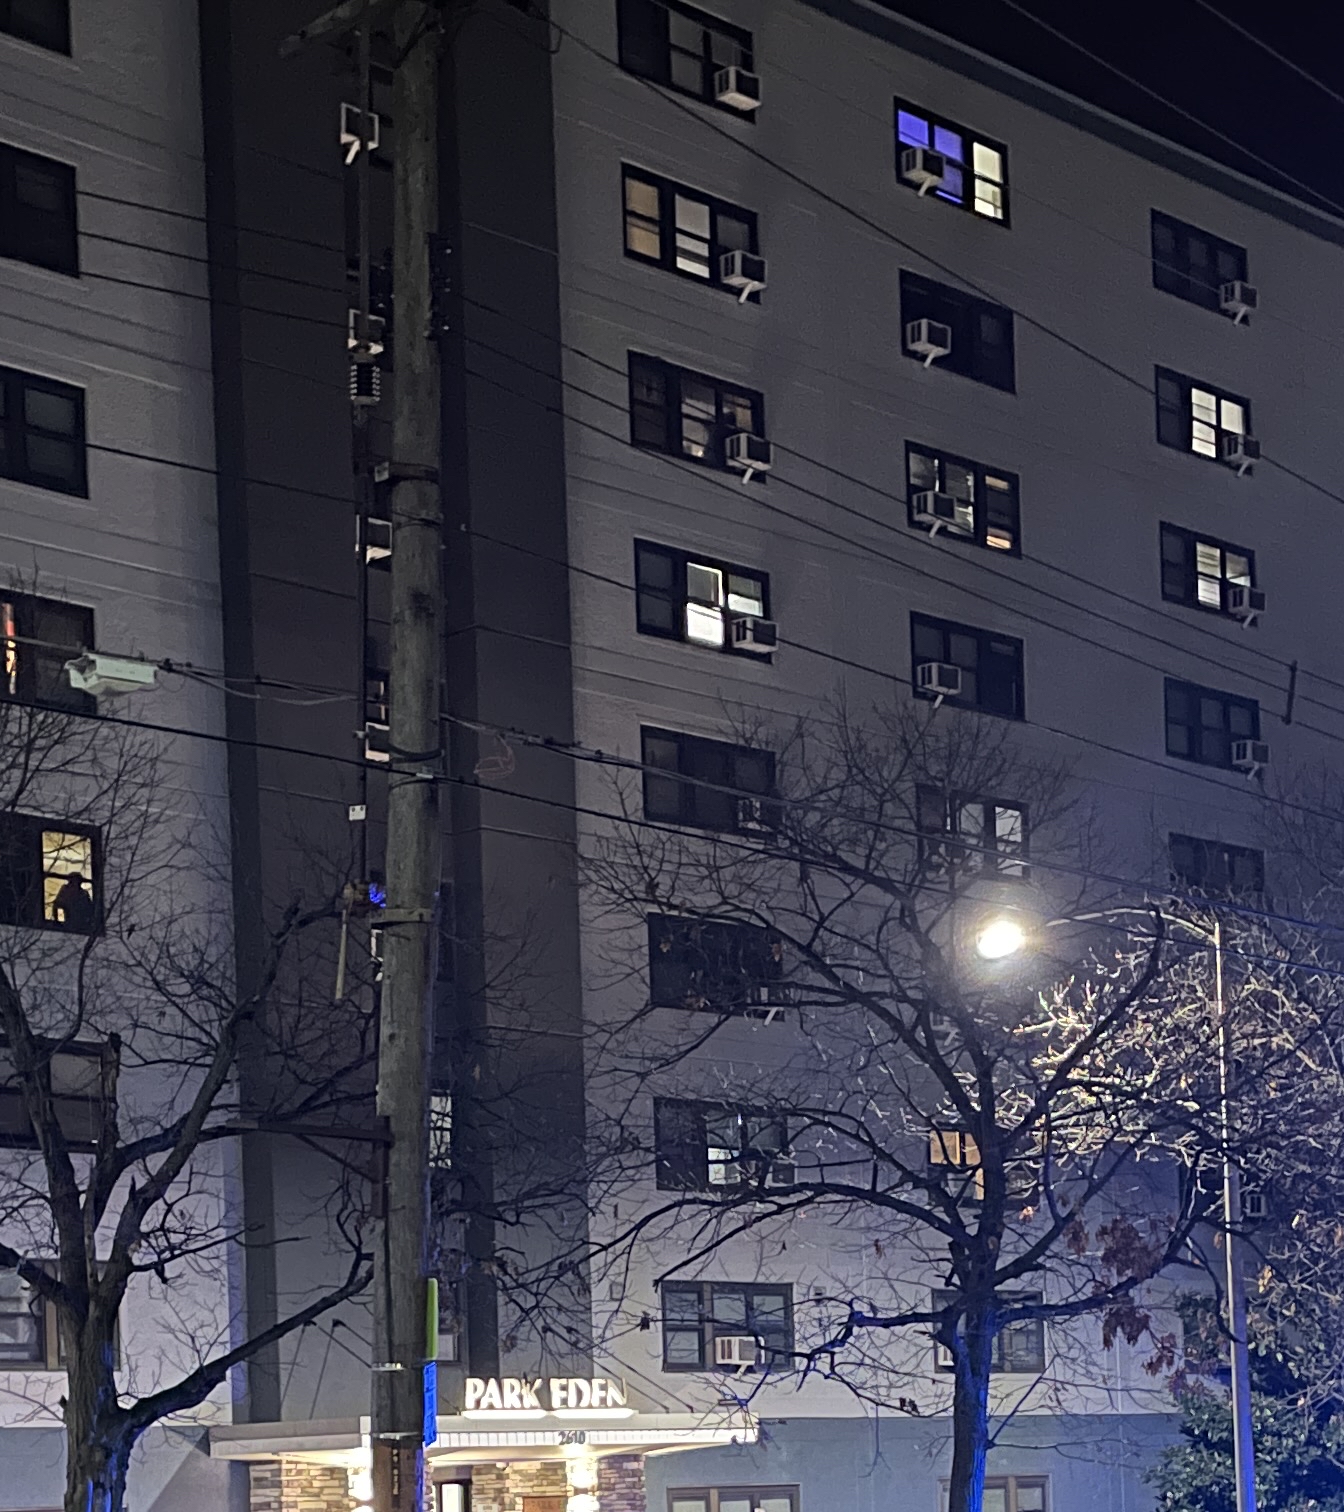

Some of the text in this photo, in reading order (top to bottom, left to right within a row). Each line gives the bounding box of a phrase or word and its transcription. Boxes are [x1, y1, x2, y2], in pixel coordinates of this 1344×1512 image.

[464, 1377, 628, 1410] PARK EDEN
[558, 1430, 586, 1446] 2610
